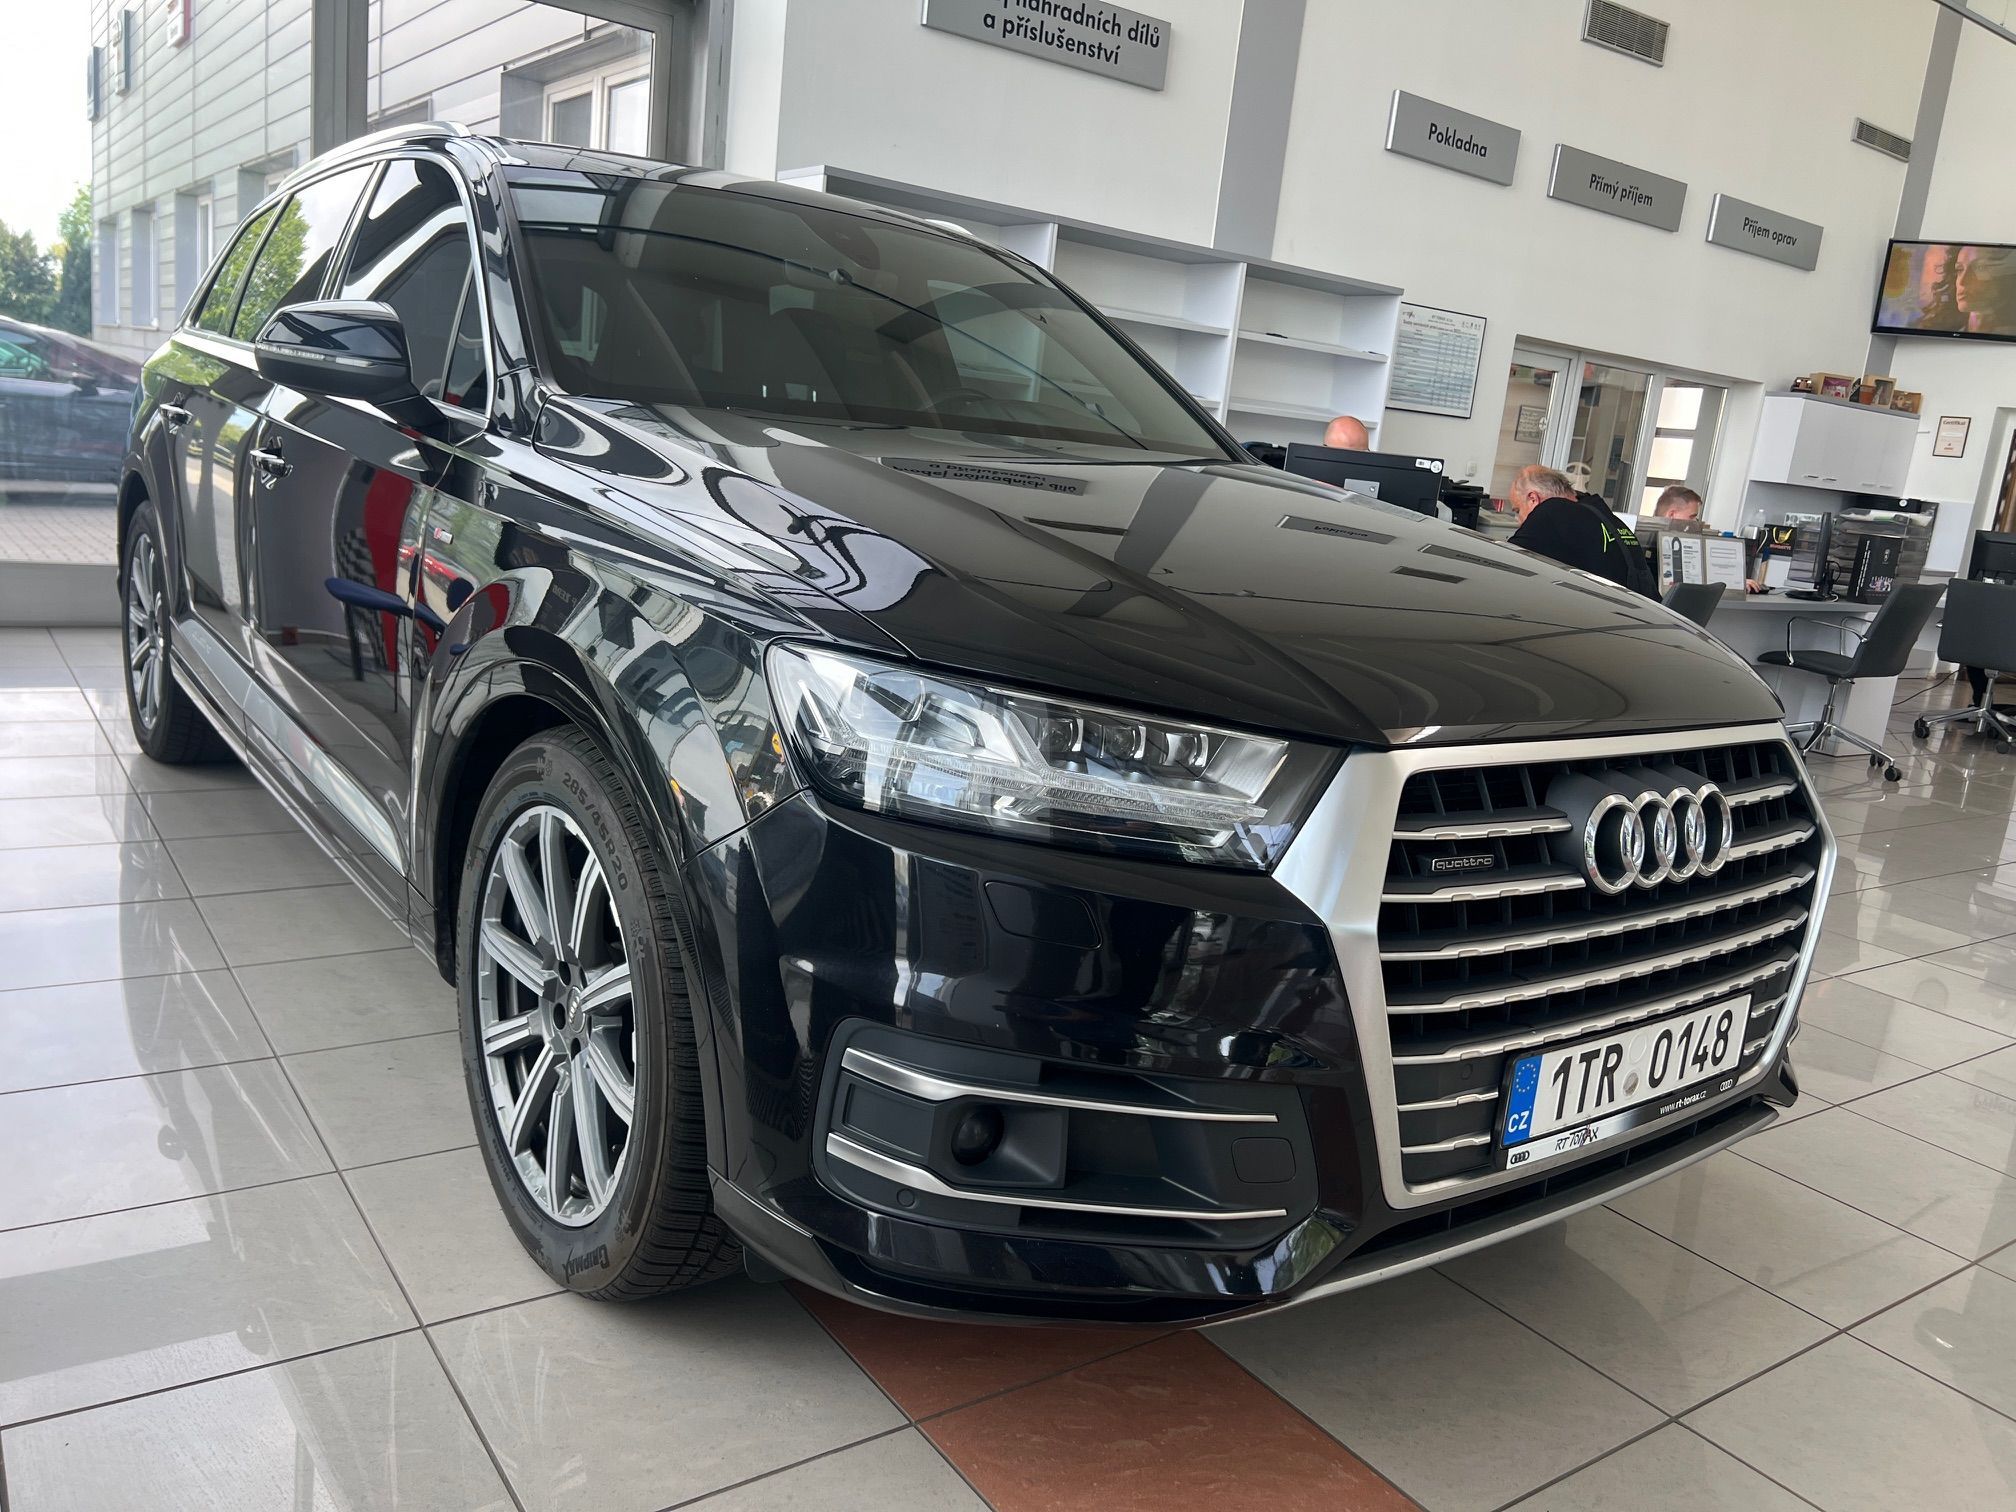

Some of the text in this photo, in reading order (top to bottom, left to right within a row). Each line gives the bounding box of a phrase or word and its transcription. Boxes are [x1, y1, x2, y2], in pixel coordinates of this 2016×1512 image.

[983, 13, 1121, 65] a příslušenství
[1127, 20, 1161, 48] dílů
[1428, 122, 1488, 158] Pokladna
[1589, 173, 1653, 207] Přímý příjem
[1743, 217, 1797, 246] Příjem oprav
[1436, 857, 1492, 870] quattro
[1552, 1009, 1733, 1121] 1TR 0148
[1508, 1111, 1529, 1133] CZ
[1555, 1136, 1570, 1151] RT
